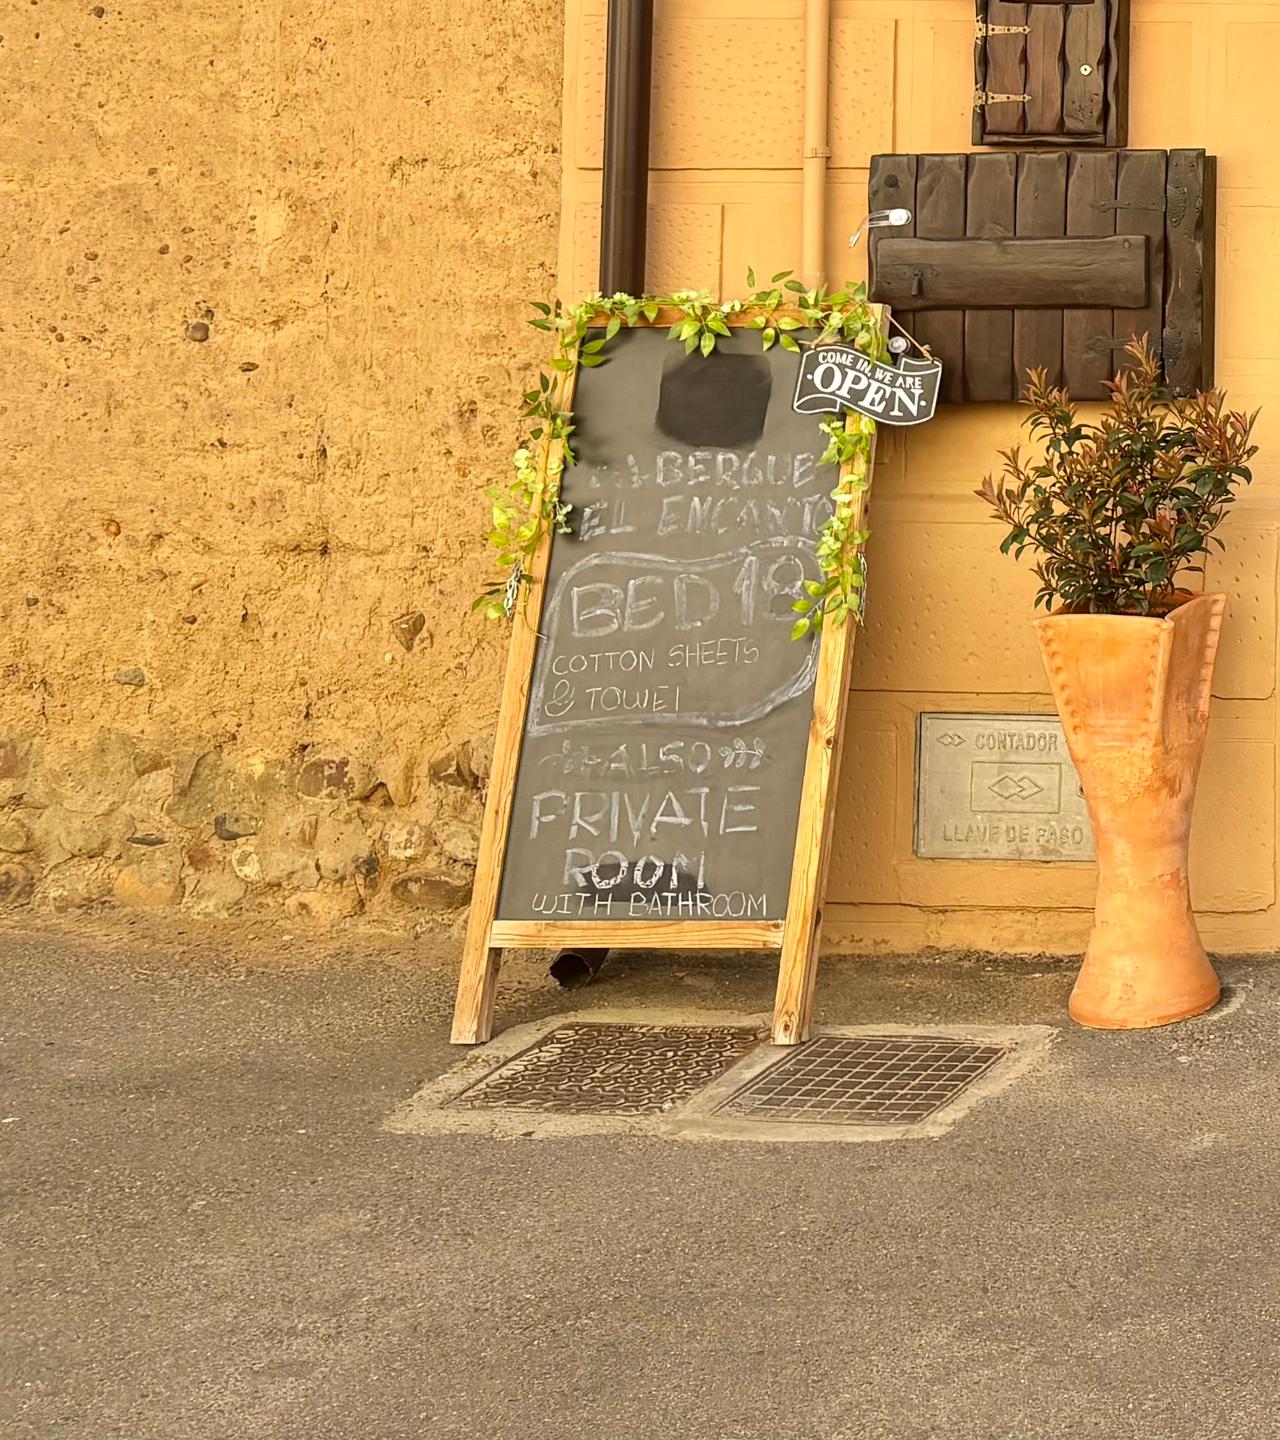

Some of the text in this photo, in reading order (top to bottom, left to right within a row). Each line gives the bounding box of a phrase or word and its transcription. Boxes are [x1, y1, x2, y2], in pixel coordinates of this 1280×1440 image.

[818, 351, 854, 366] COME
[875, 369, 894, 385] WE
[895, 376, 922, 389] ARE
[813, 363, 924, 417] OPEN
[579, 499, 637, 541] EL
[571, 574, 720, 638] BED
[553, 637, 760, 676] COTTON SHEETS
[610, 741, 712, 777] ALSO
[975, 731, 1058, 752] CONTADOR
[529, 785, 761, 845] PRIVATE
[943, 824, 1083, 844] LLAVE DE PASO
[562, 848, 705, 889] ROOM
[532, 891, 767, 917] WITH BATHROOM
